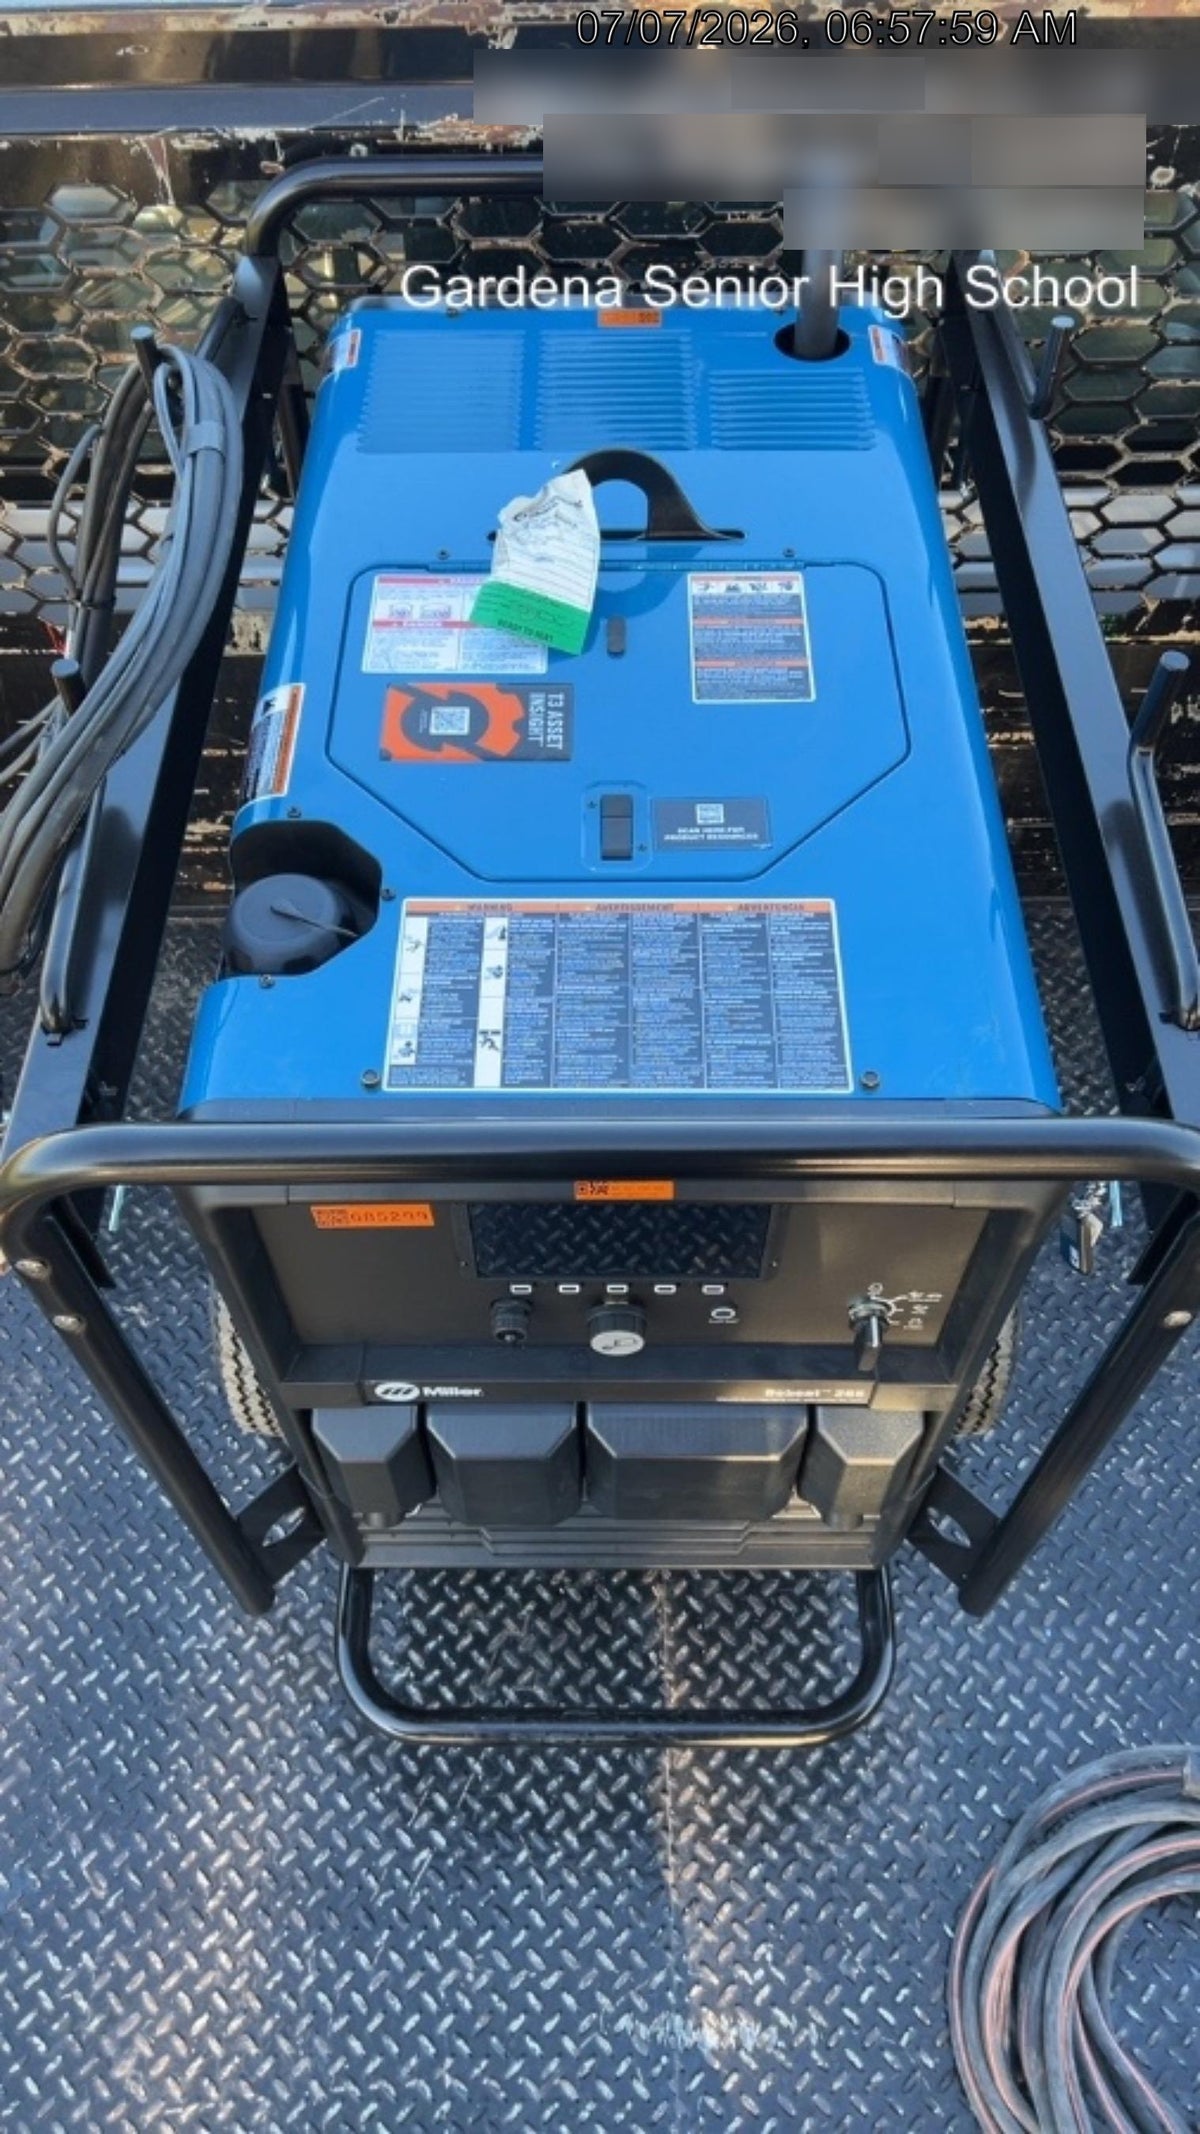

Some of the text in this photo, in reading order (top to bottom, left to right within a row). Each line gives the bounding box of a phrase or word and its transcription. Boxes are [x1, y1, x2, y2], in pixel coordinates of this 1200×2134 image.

[528, 692, 546, 748] INSIGHT
[546, 692, 564, 750] T3 ASSET
[467, 902, 514, 912] WARNING
[421, 1386, 483, 1398] Miller
